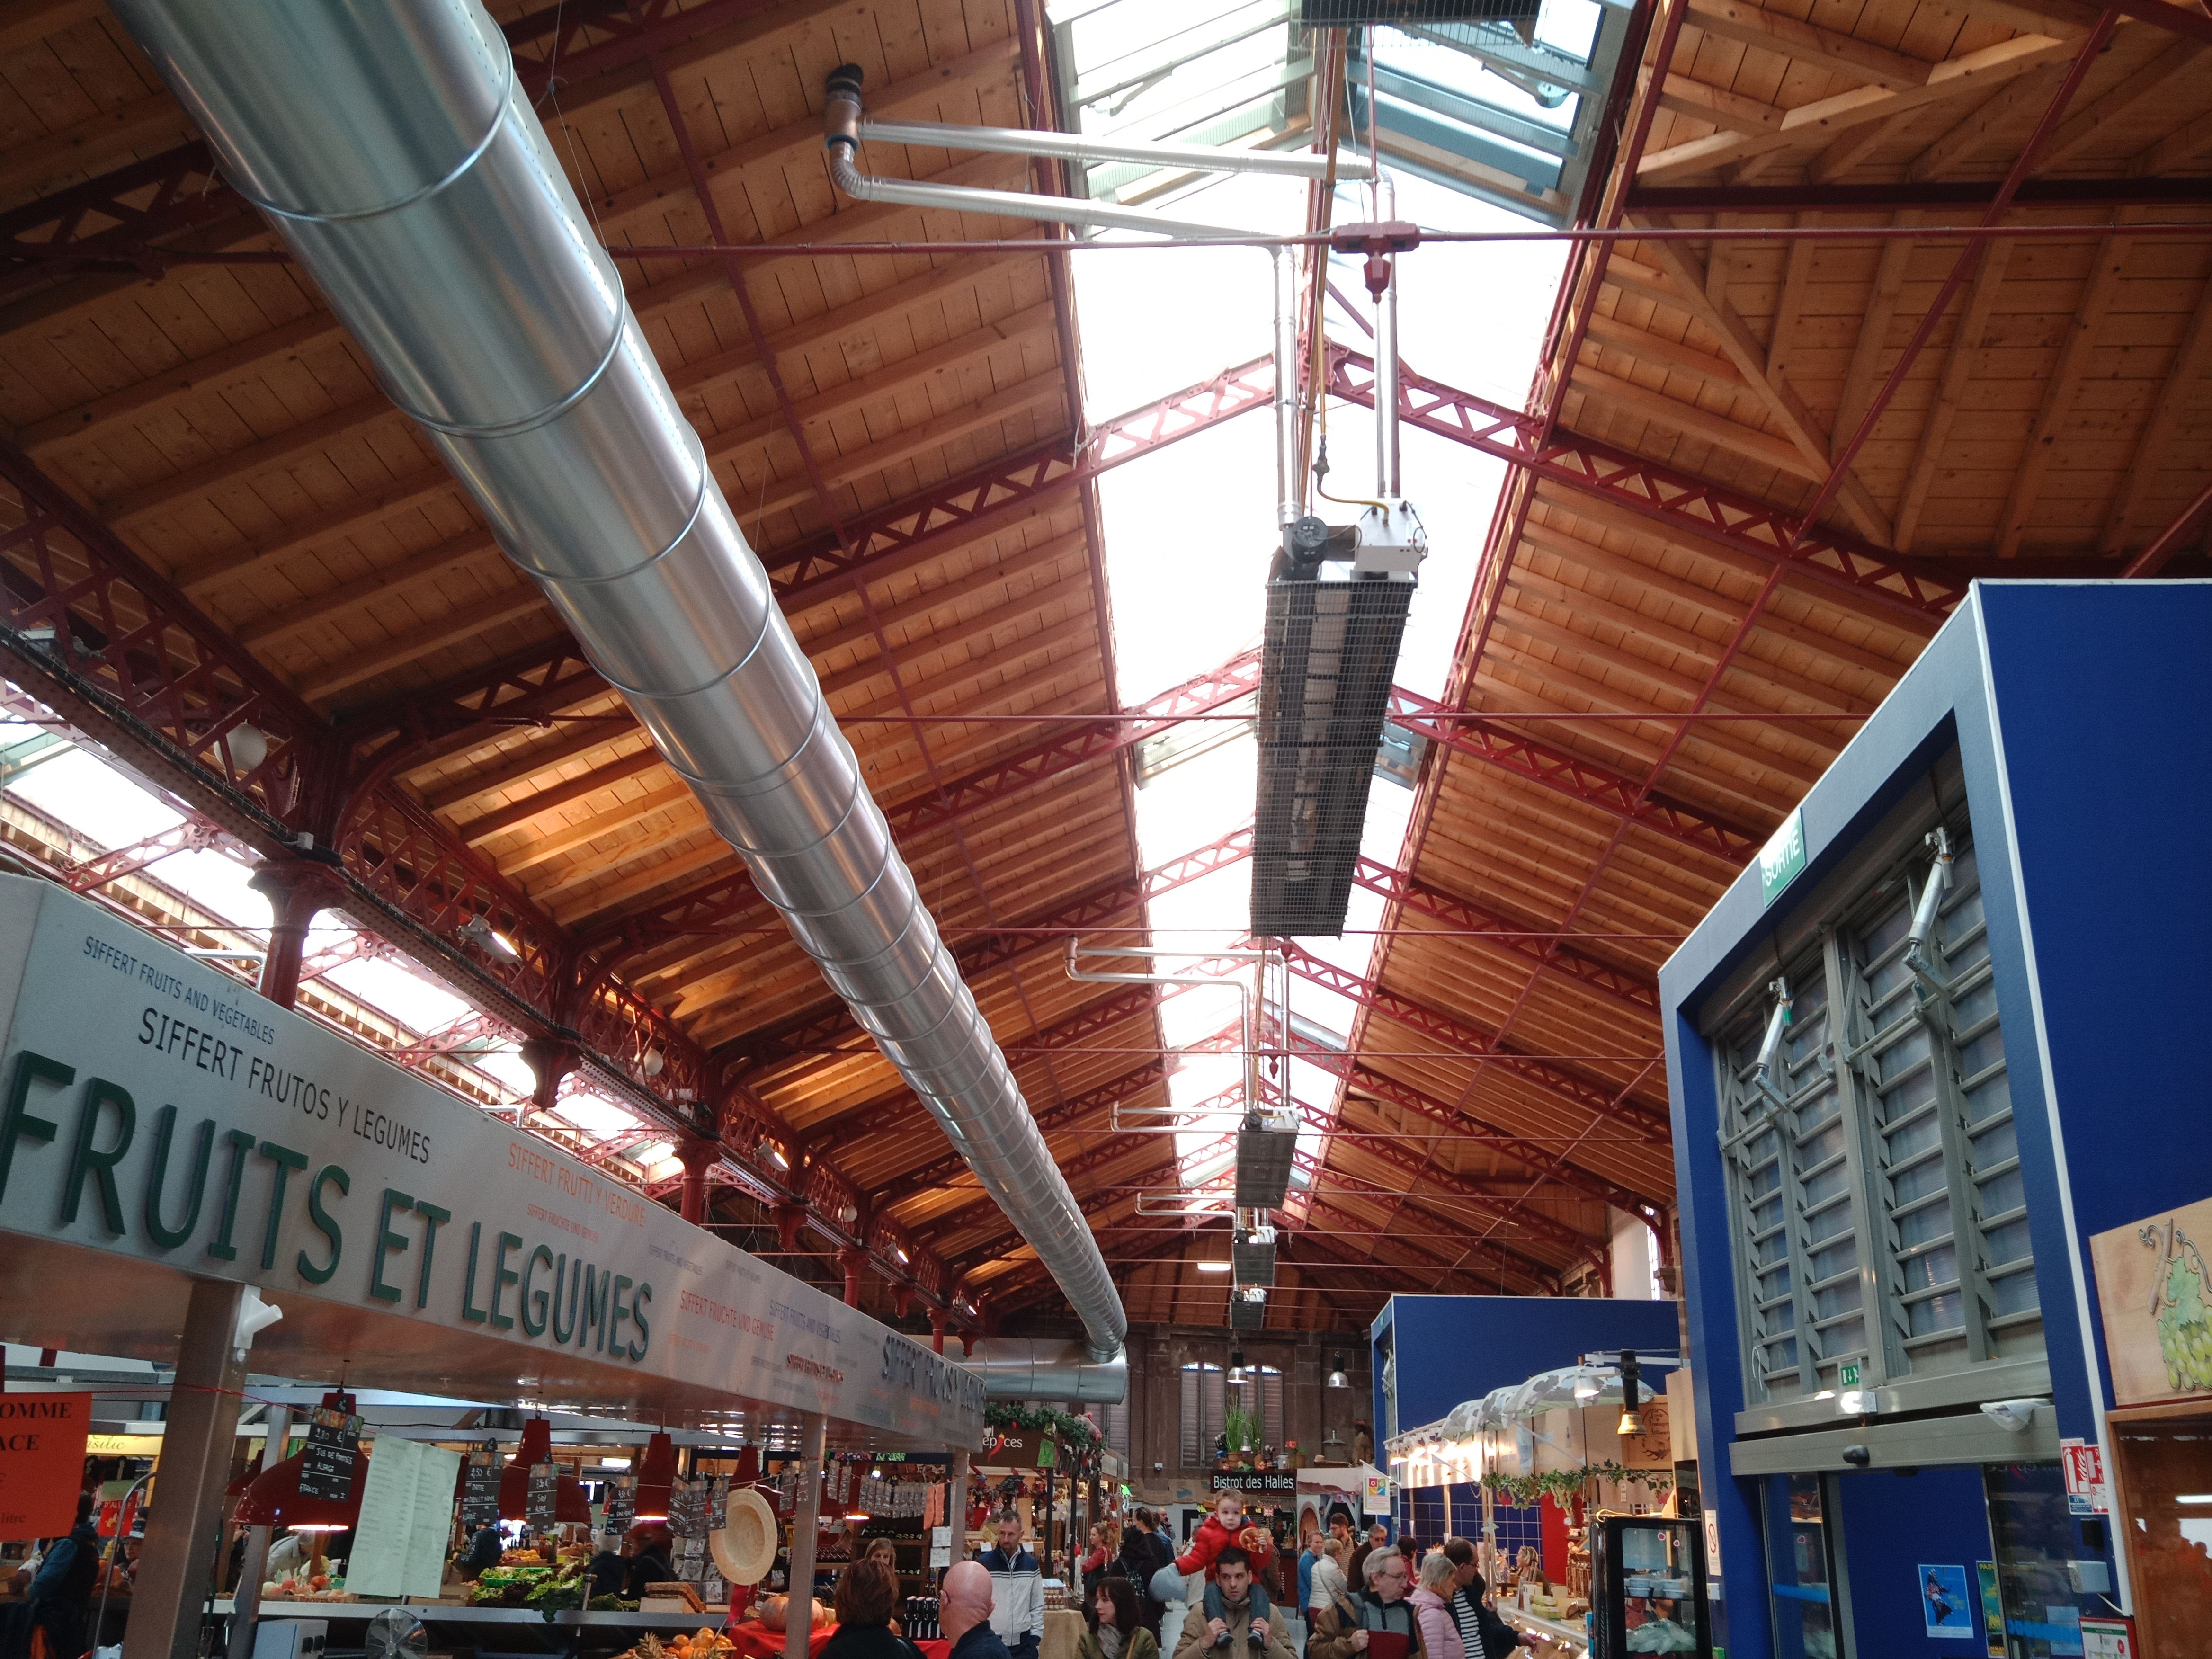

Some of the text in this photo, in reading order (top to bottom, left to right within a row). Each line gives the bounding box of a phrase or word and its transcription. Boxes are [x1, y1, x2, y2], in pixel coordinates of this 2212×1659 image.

[83, 936, 275, 1044] SIFFERT FRUITS AND VEGETABLES
[138, 1007, 430, 1165] SIFFERT FRUTOS Y LEGUMES
[0, 1050, 652, 1362] FRUITS ET LEGUMES
[508, 1142, 645, 1228] SIFFERT FRUTTI Y VERDURE
[680, 1290, 708, 1317] SIFFERT
[315, 1447, 326, 1457] JUS
[327, 1451, 335, 1459] DE
[1213, 1474, 1294, 1489] Bistrot des Halles
